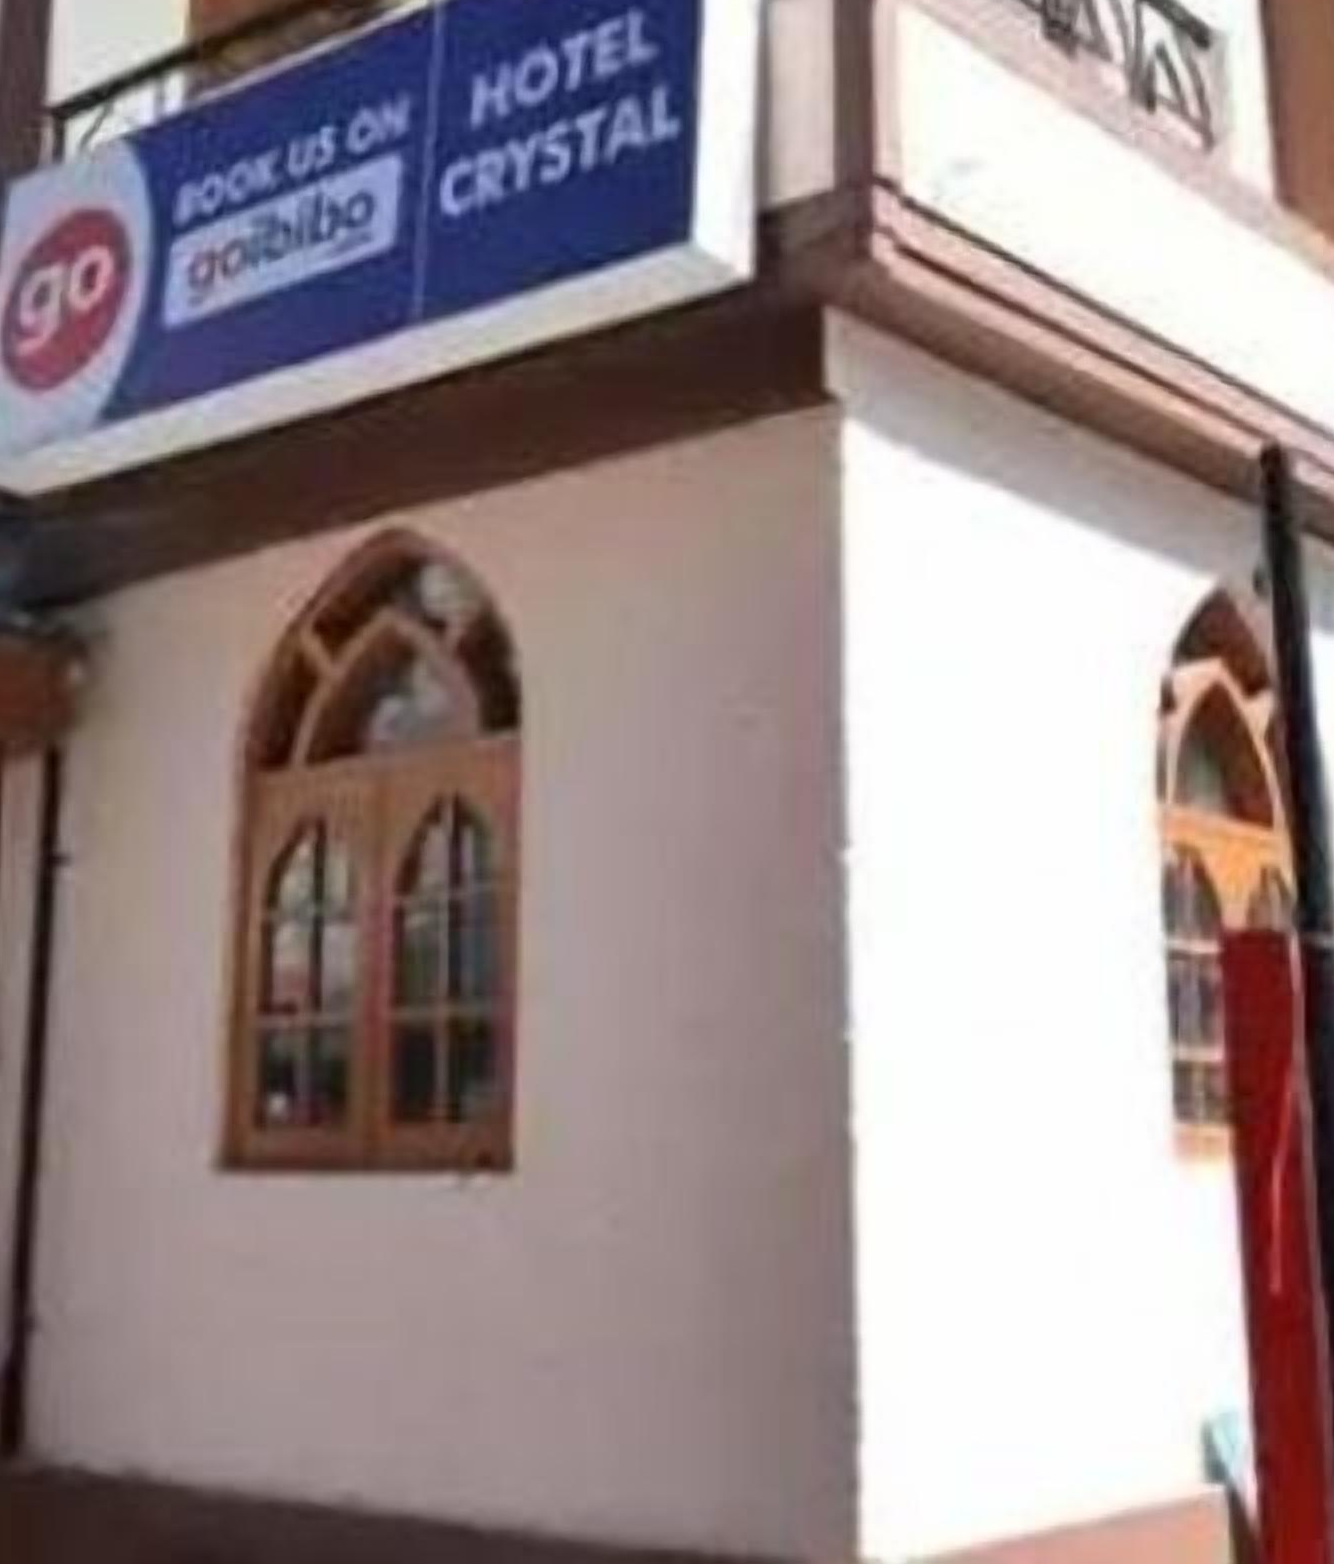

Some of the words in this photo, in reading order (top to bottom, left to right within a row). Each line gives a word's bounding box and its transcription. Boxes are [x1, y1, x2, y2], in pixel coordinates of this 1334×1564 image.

[470, 7, 660, 129] HOTEL
[176, 153, 278, 225] BOOK
[286, 126, 338, 174] US
[346, 92, 413, 152] ON
[438, 83, 682, 218] CRYSTAL
[15, 244, 111, 354] go
[186, 185, 375, 304] goibibo
